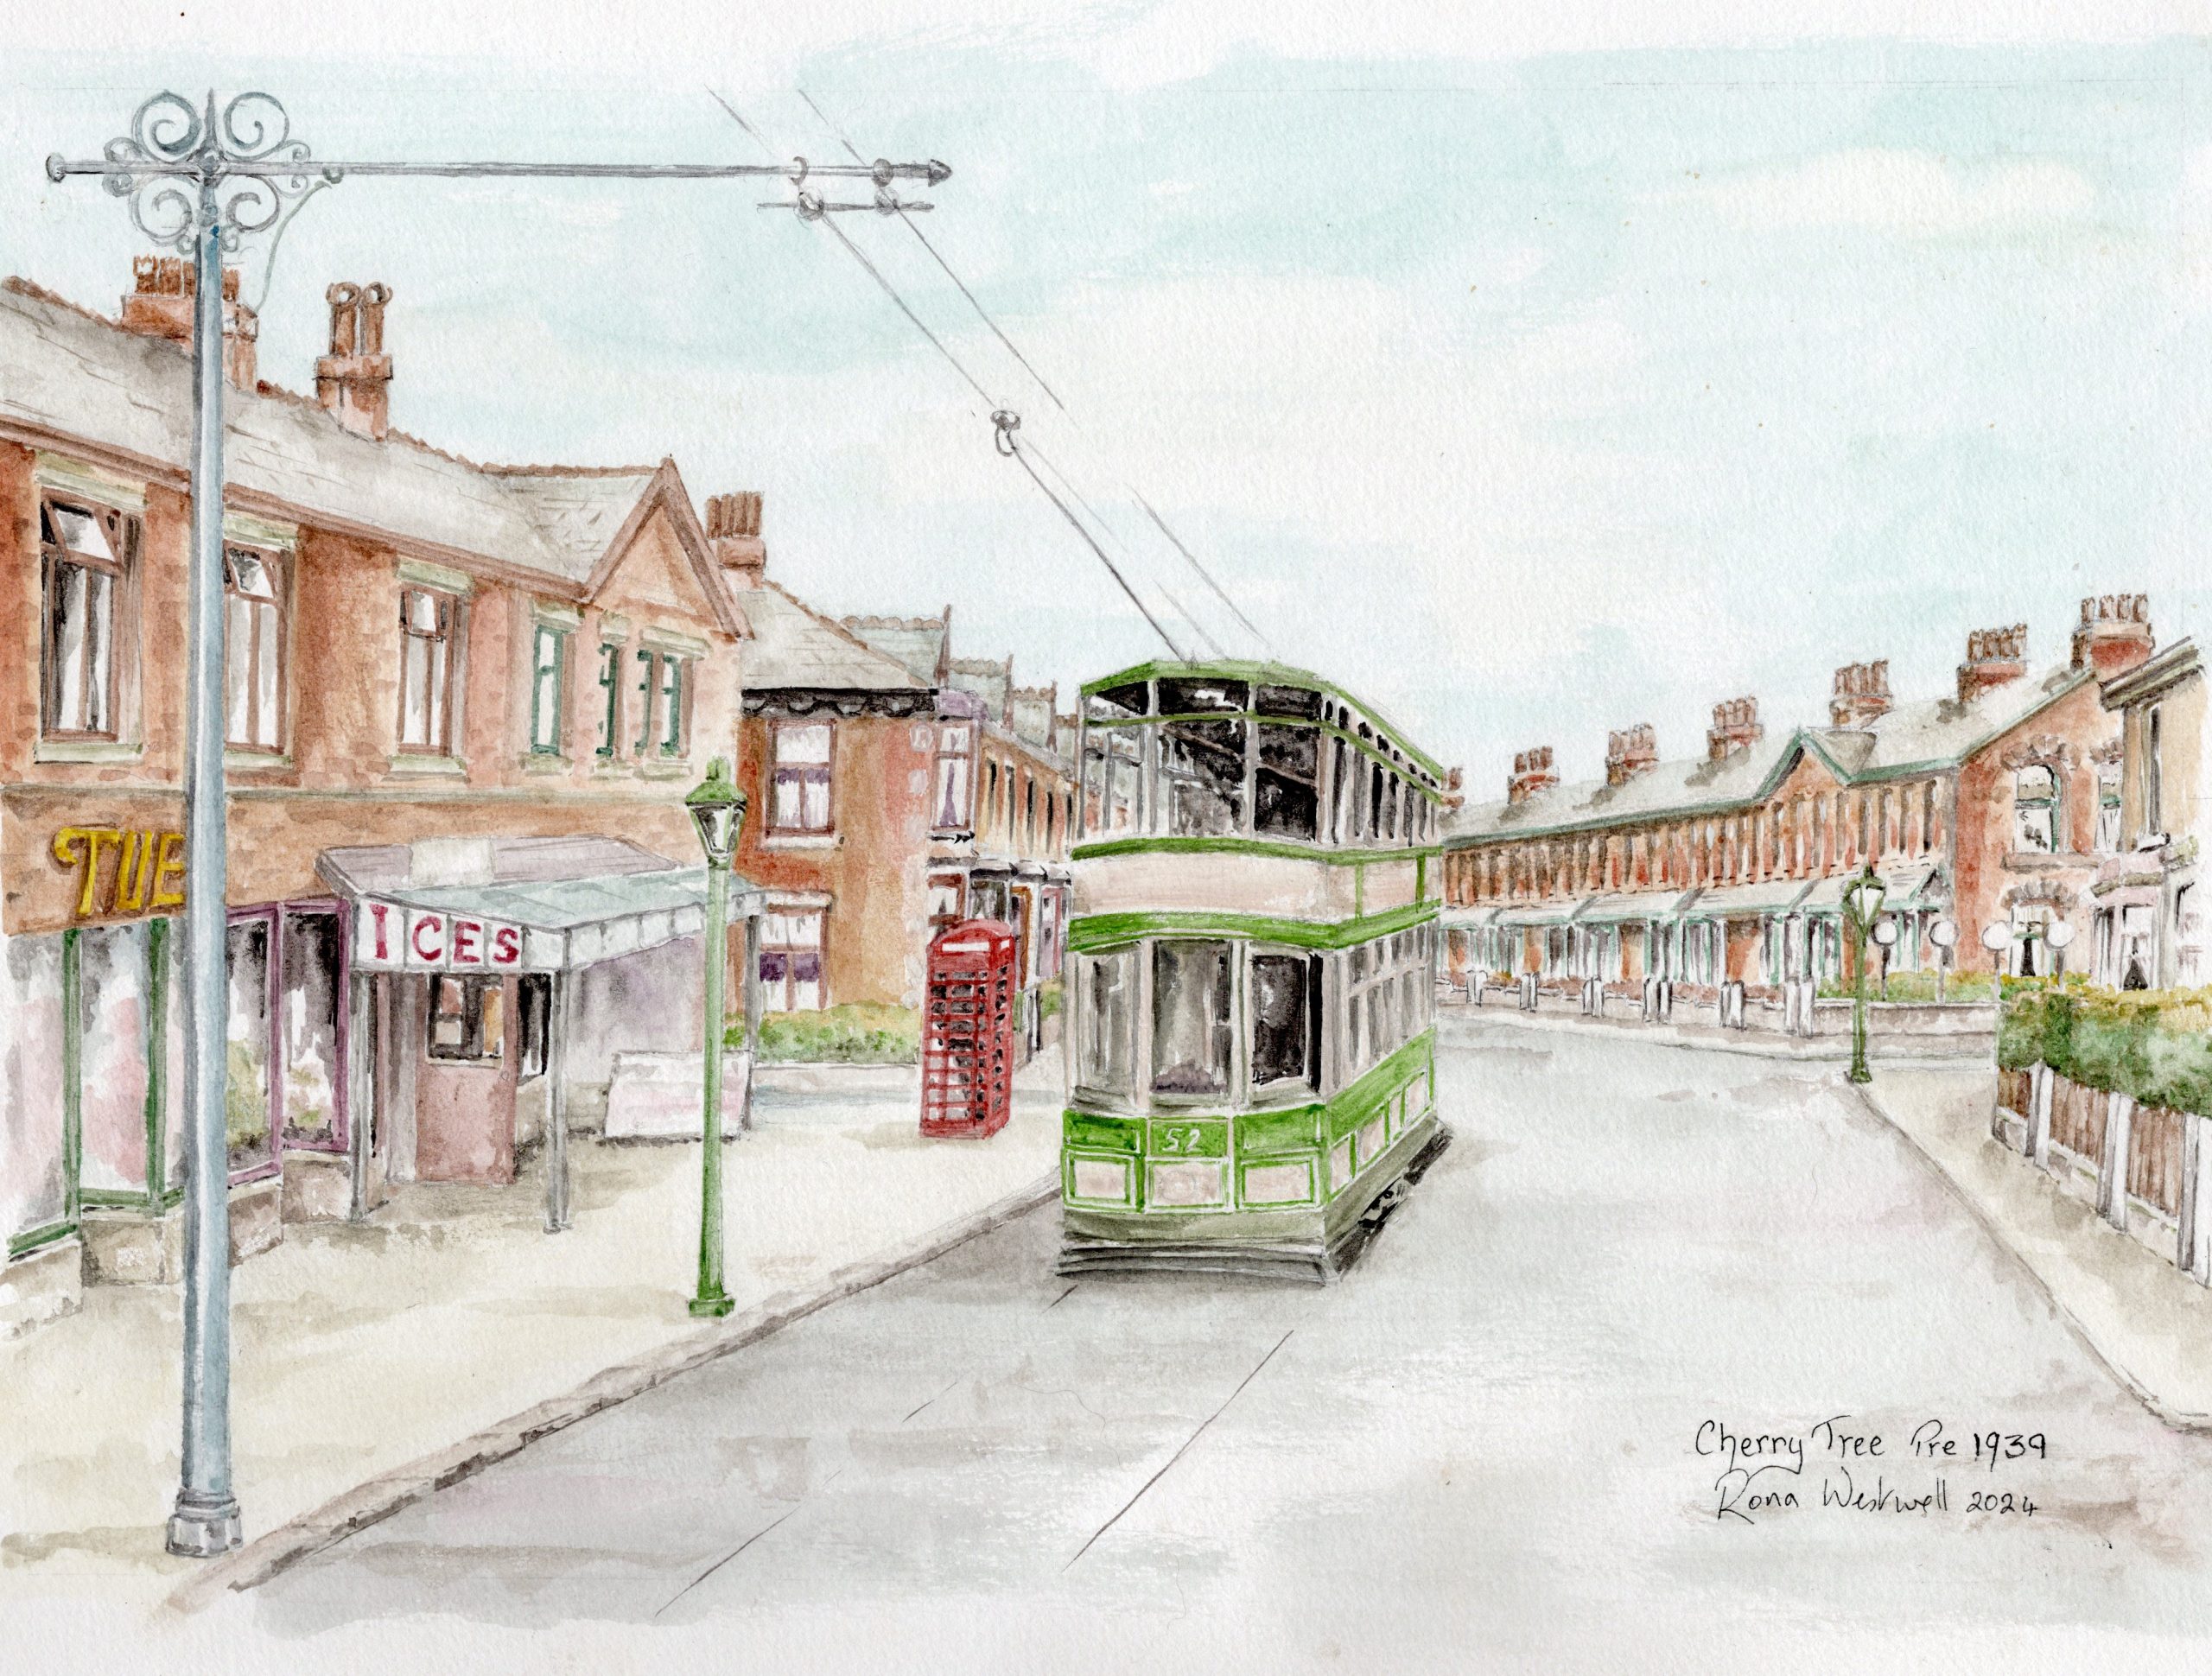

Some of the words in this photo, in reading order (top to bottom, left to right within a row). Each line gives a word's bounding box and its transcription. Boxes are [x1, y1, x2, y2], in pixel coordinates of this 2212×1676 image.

[369, 904, 523, 965] ICES
[1161, 1127, 1204, 1153] 52
[1695, 1419, 1803, 1475] Cherry
[1812, 1415, 1885, 1458] Tree
[1910, 1419, 1957, 1458] Pre
[1974, 1432, 2046, 1472] 1939
[1715, 1468, 1799, 1525] Rona
[1822, 1466, 1948, 1514] Westwell
[1965, 1492, 2039, 1517] 2024
